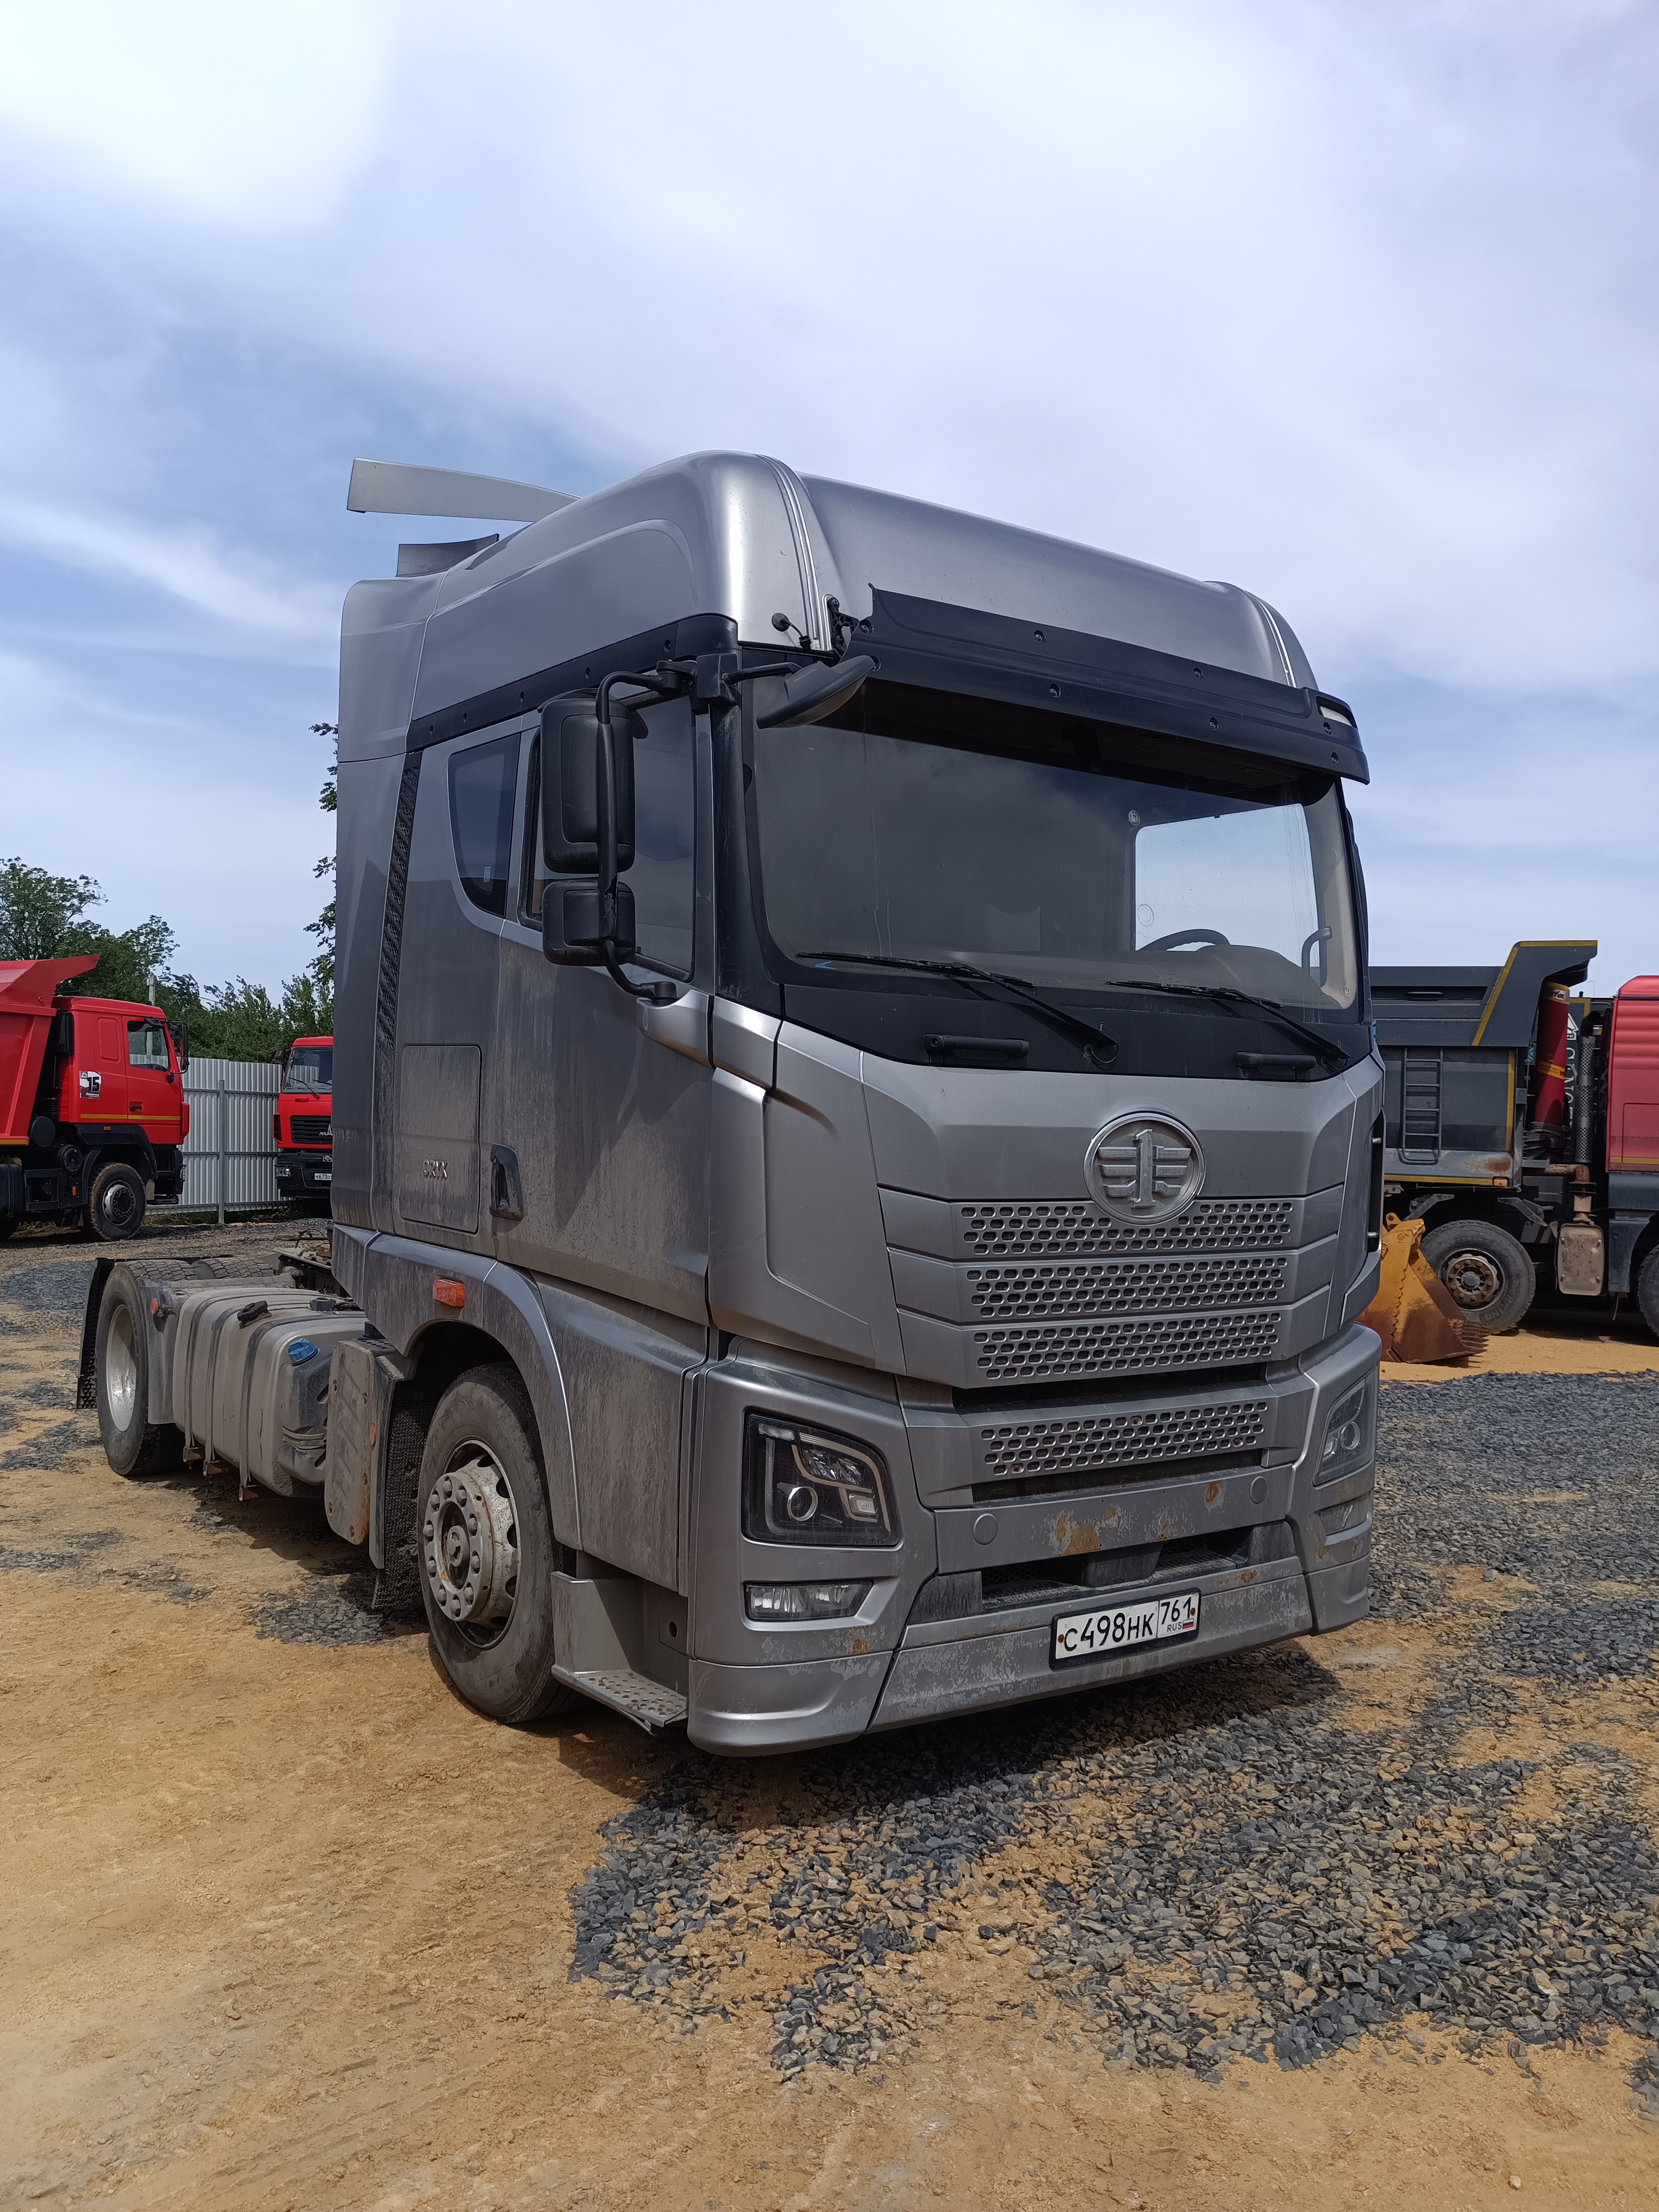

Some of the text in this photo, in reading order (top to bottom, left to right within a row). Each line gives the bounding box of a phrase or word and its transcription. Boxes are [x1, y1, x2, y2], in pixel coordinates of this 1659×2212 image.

[87, 1076, 100, 1092] 15
[1064, 1596, 1191, 1651] С498НК 761
[1167, 1622, 1182, 1633] RUS
